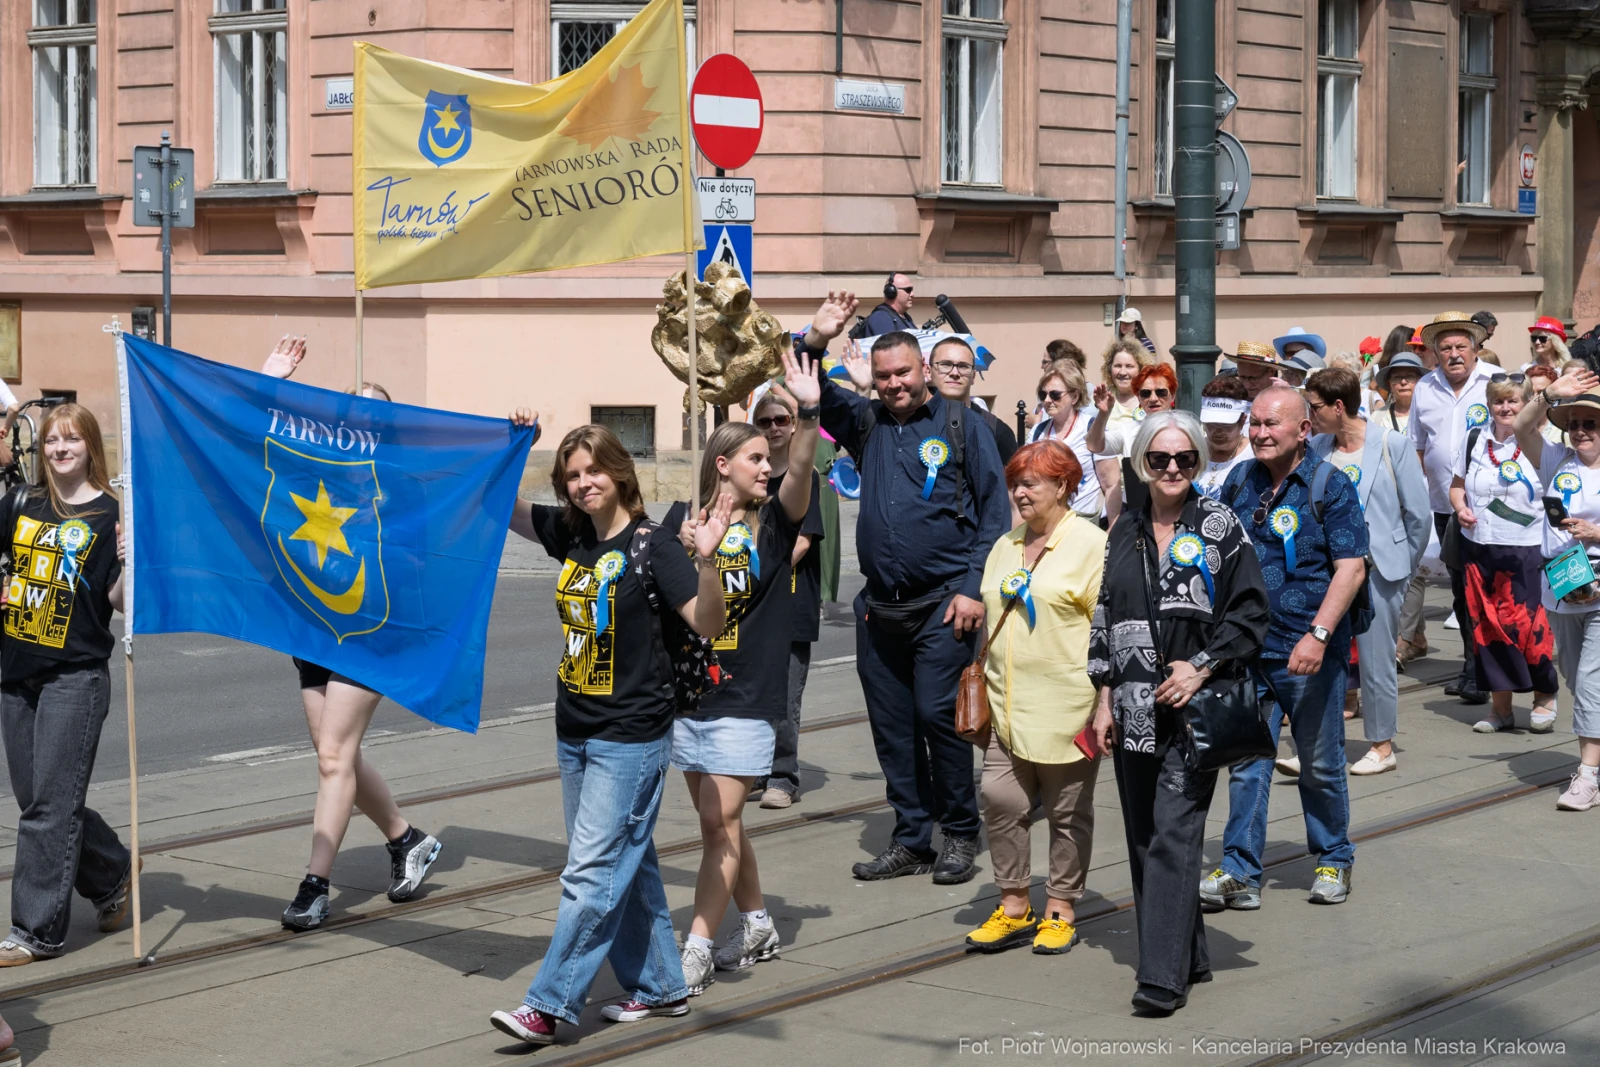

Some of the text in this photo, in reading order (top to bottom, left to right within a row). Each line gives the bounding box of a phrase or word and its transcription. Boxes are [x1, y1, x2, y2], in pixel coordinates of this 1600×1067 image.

[841, 93, 901, 109] STRASZEWSKIEGO
[629, 135, 682, 158] RADA
[700, 181, 754, 197] Nie dotyczy
[366, 176, 490, 228] Tarnów
[267, 407, 381, 456] TARNÓW
